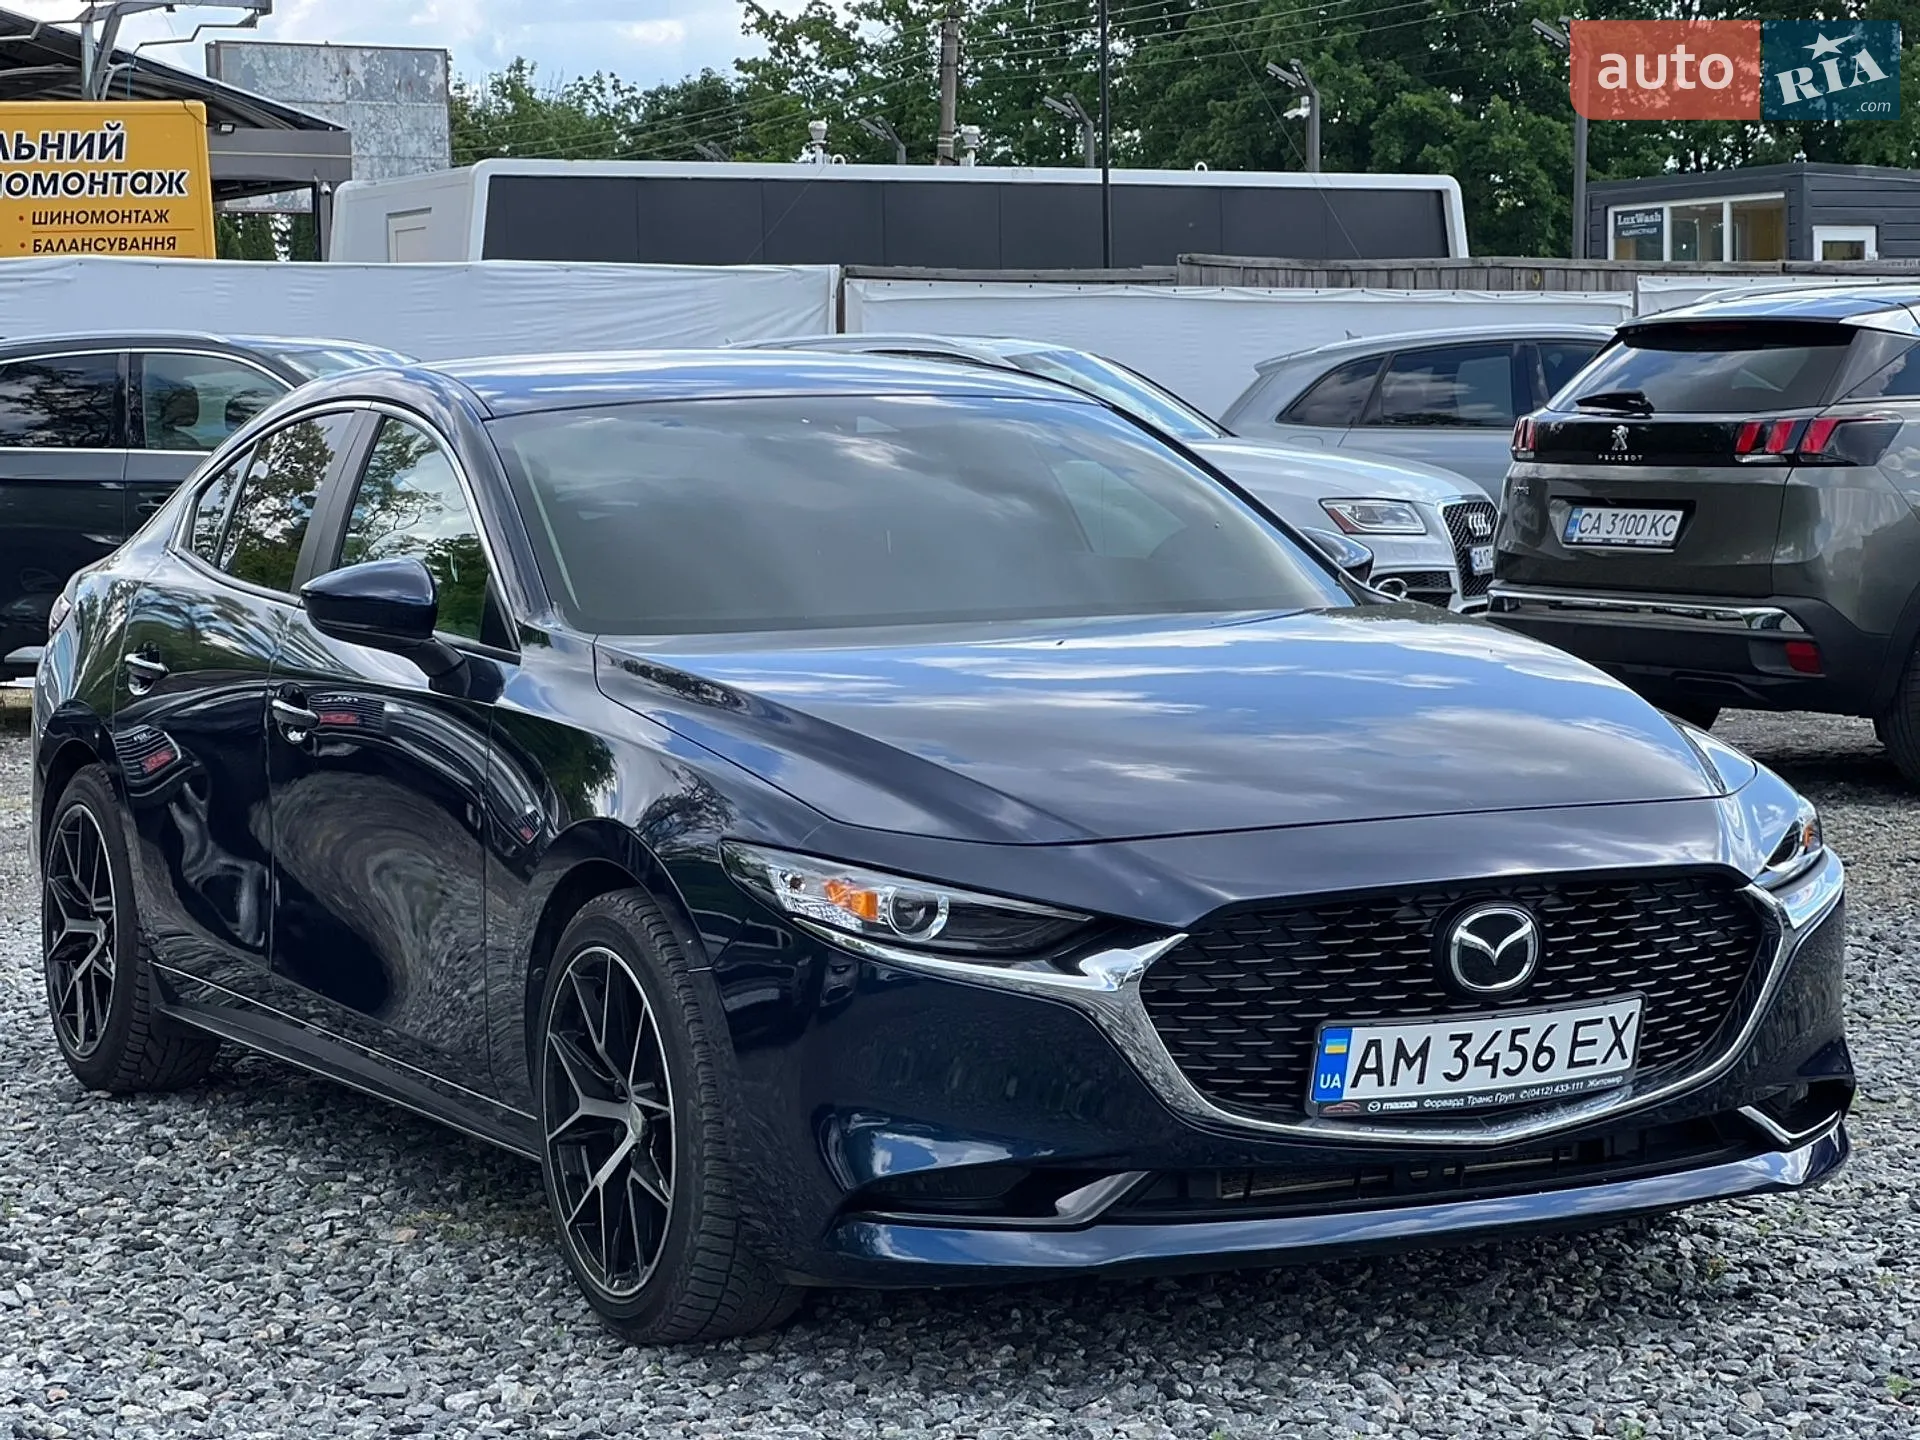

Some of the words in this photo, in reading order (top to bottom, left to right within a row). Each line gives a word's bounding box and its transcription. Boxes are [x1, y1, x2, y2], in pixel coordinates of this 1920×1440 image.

[32, 209, 169, 225] ШИНОМОНТАЖ
[1617, 212, 1661, 225] LuxWash
[33, 236, 176, 253] БАЛАНСУВАННЯ
[1598, 454, 1643, 462] PEUGEOT
[1578, 512, 1600, 535] CA
[1606, 513, 1646, 536] 3100
[1648, 514, 1678, 537] KC
[1350, 1034, 1432, 1089] AM
[1442, 1024, 1559, 1083] 3456
[1567, 1011, 1636, 1070] EX
[1319, 1074, 1341, 1089] UA
[1382, 1101, 1418, 1110] mazda
[1423, 1097, 1465, 1109] Форвард
[1467, 1093, 1493, 1106] Транс
[1495, 1091, 1515, 1104] Груп
